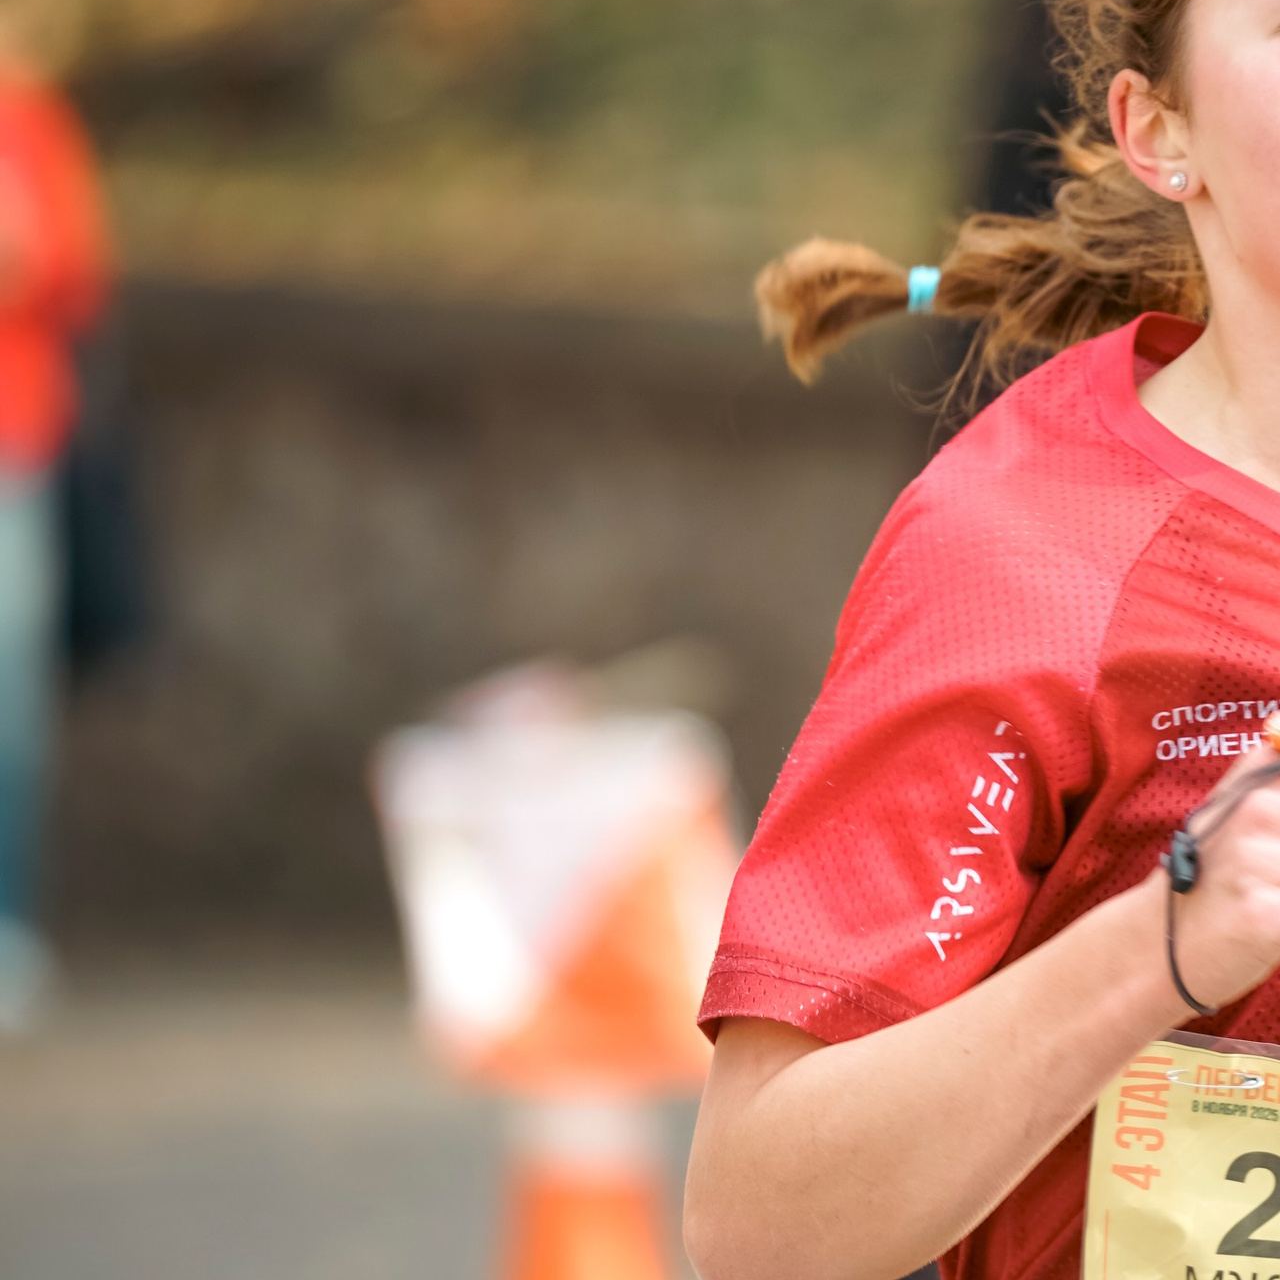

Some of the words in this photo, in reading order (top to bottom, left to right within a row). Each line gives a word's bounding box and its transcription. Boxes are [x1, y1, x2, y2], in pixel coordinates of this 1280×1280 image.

[1113, 1055, 1175, 1153] ЭТАП
[1191, 1100, 1200, 1113] 8
[1202, 1101, 1248, 1117] НОЯБРЯ
[1250, 1105, 1279, 1122] 2025
[1111, 1163, 1162, 1190] 4
